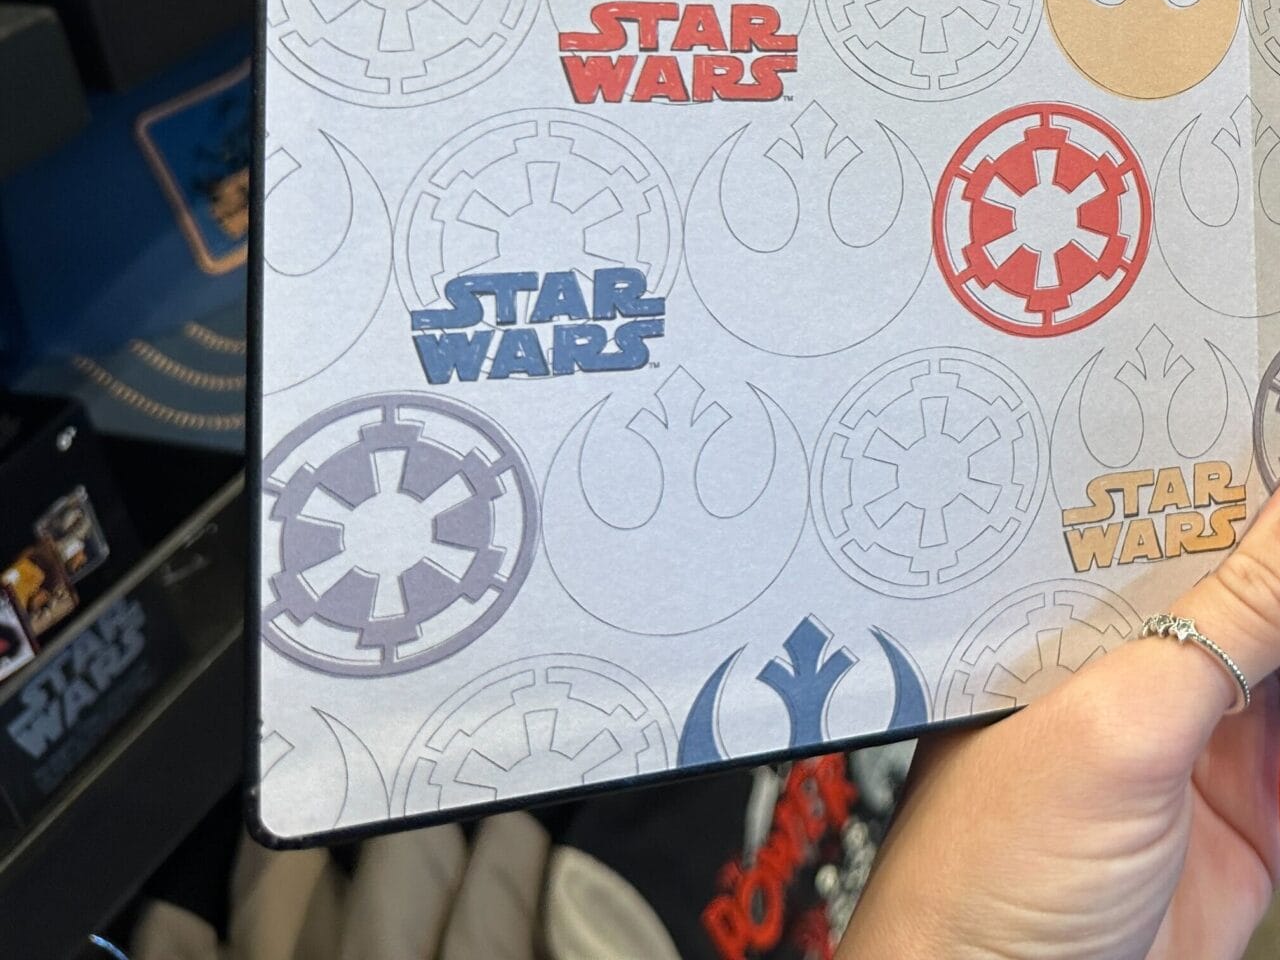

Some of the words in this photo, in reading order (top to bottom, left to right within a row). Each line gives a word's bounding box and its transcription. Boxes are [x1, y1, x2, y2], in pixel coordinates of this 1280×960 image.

[559, 1, 798, 53] STAR
[560, 54, 798, 104] WARS
[411, 267, 666, 331] STAR
[412, 318, 665, 385] WARS
[1062, 460, 1246, 527] STAR
[1063, 503, 1246, 573] WARS
